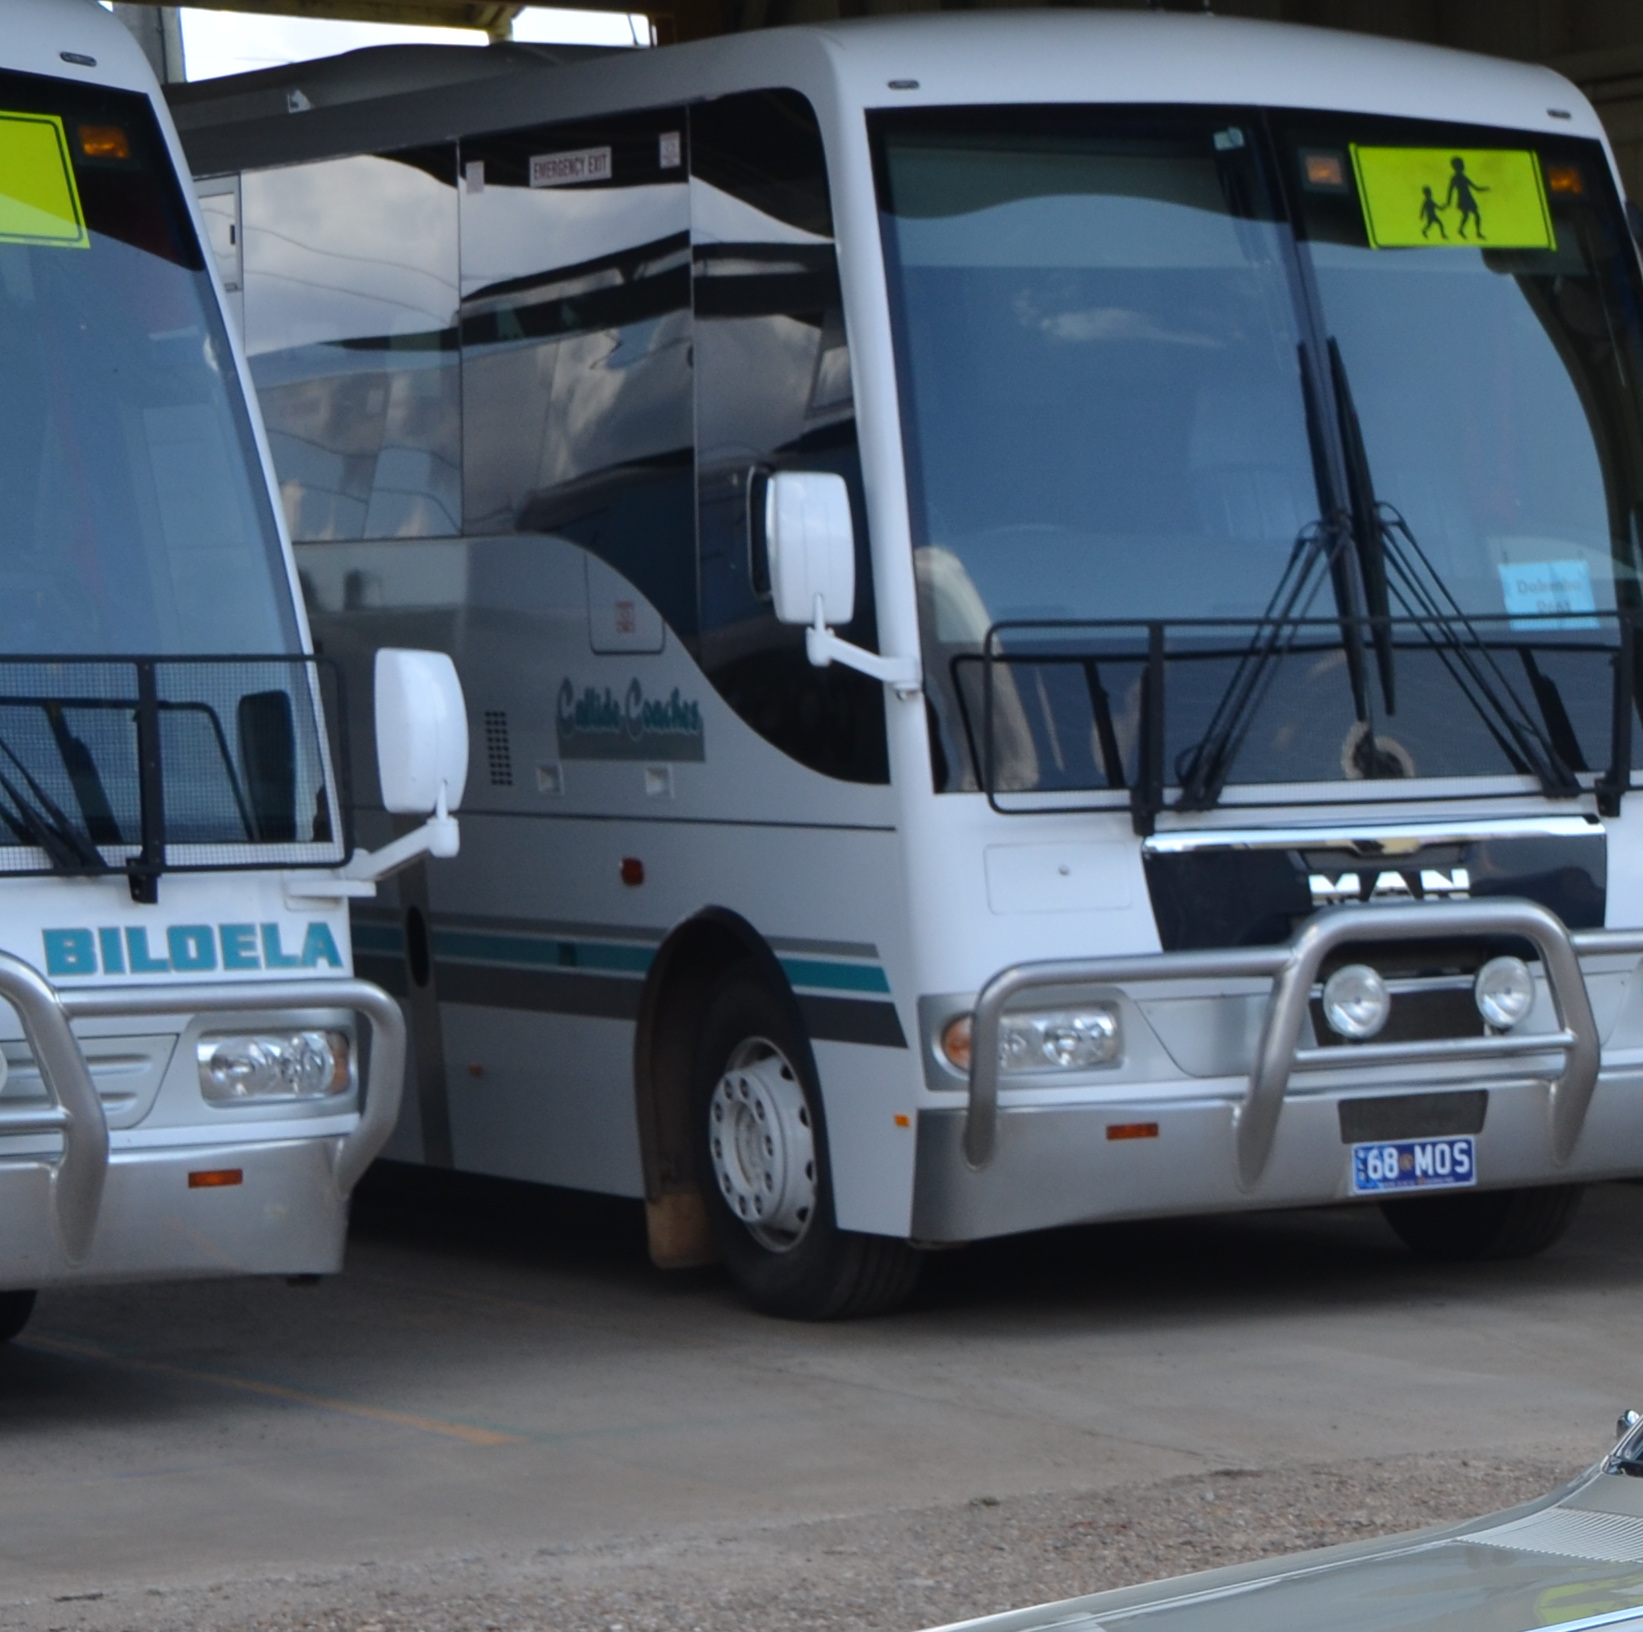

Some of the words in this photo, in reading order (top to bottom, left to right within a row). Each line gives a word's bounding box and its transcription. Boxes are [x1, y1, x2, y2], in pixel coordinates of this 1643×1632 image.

[534, 158, 585, 180] EMERGENCY
[588, 154, 607, 173] EXIT
[1308, 868, 1470, 906] MAN
[42, 922, 344, 977] BILOELA
[1366, 1146, 1399, 1180] 68
[1414, 1141, 1470, 1177] MOS
